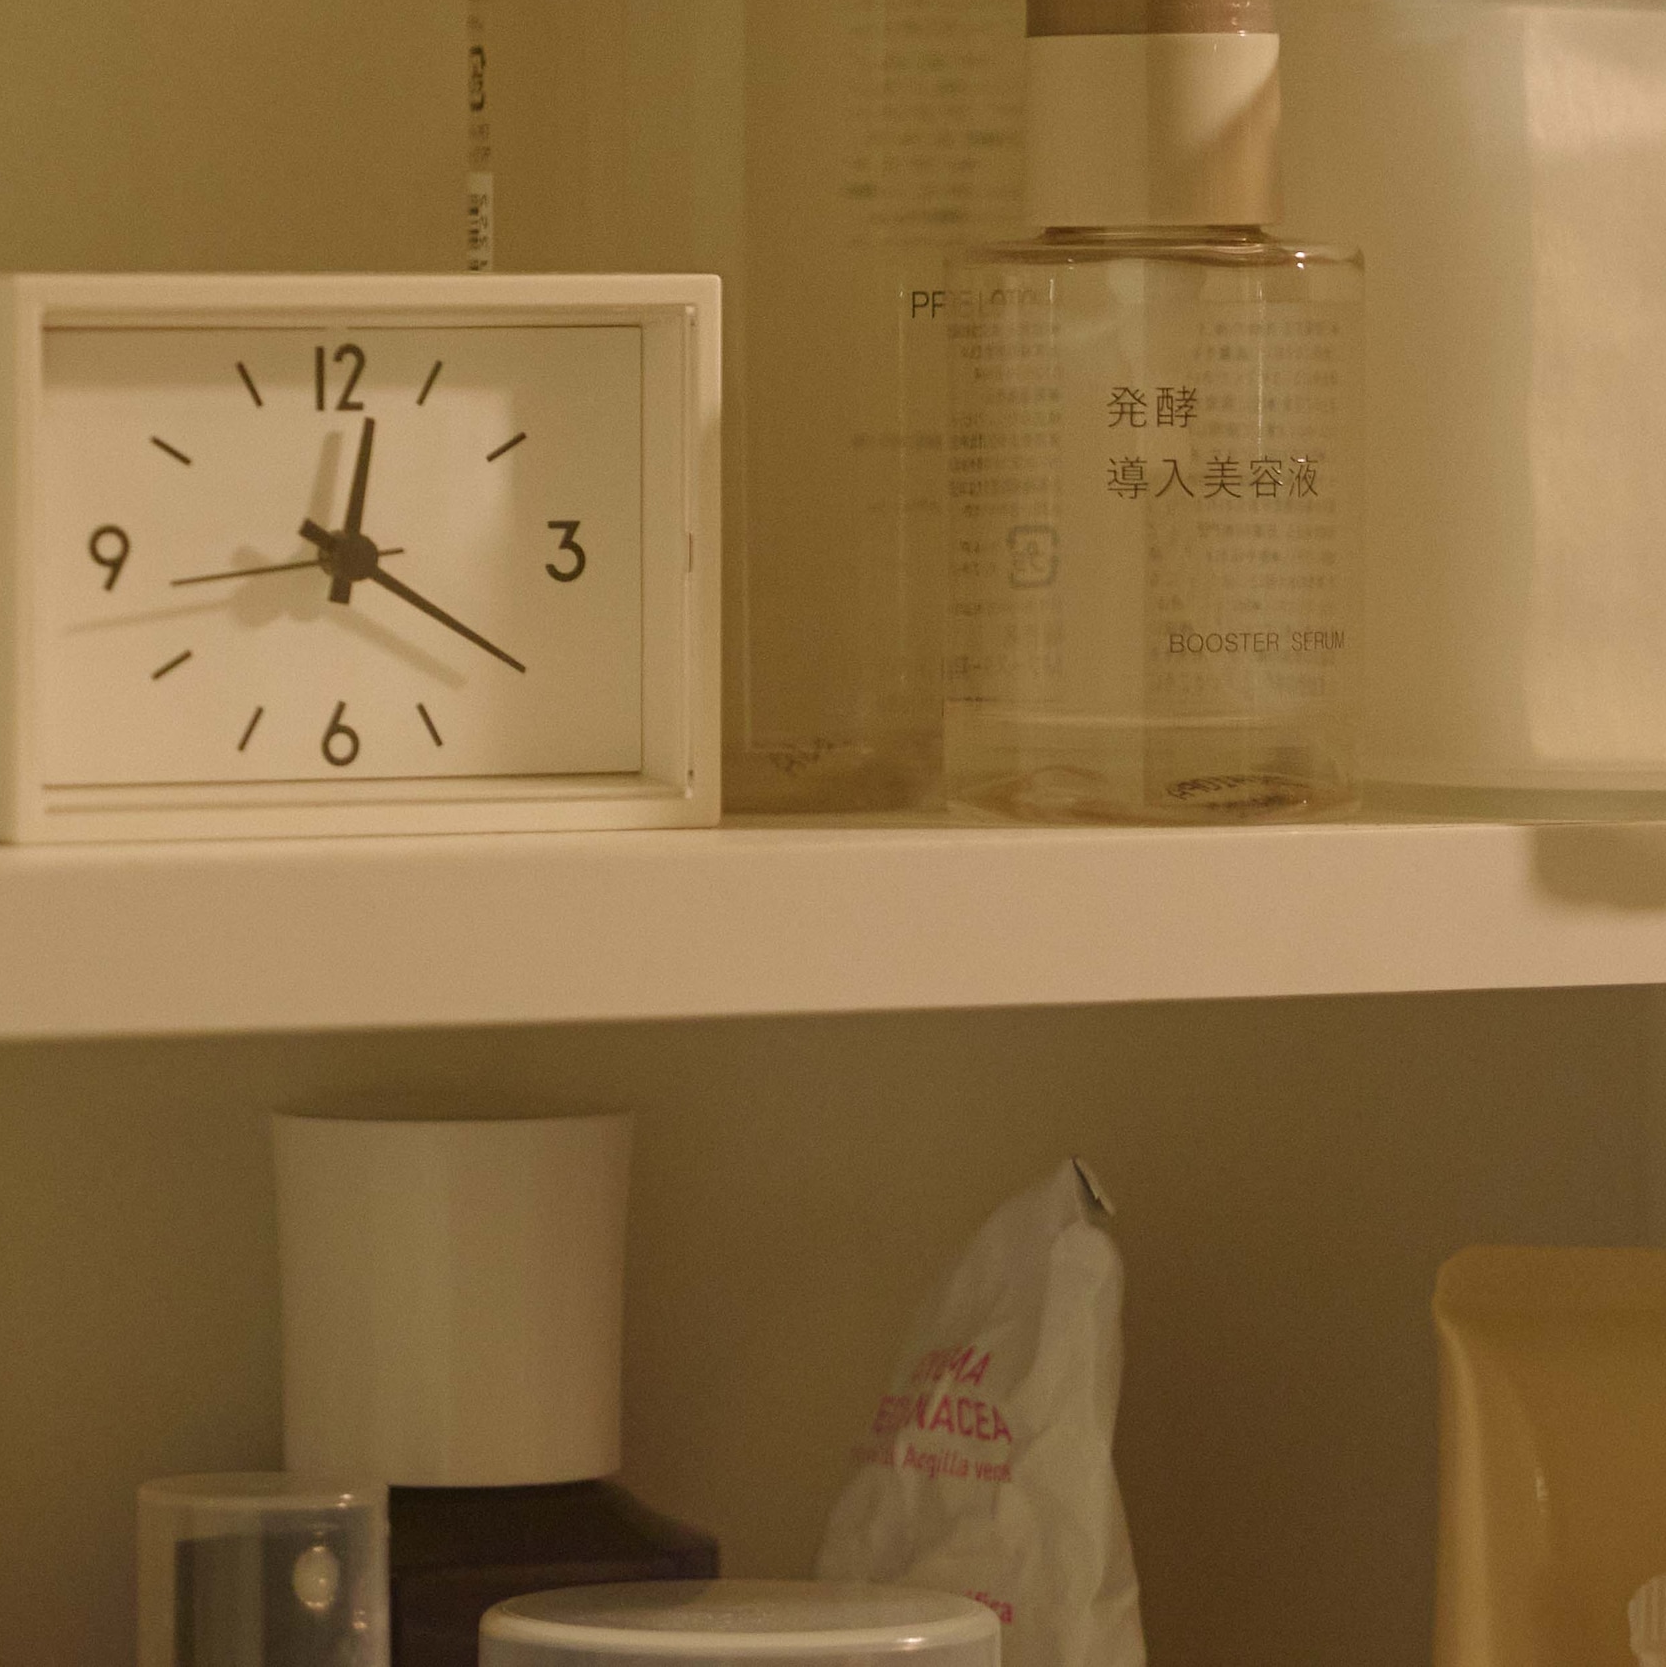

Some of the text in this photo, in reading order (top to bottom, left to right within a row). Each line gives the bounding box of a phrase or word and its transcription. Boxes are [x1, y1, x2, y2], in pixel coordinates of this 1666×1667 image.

[315, 343, 366, 411] 12
[1107, 385, 1199, 429] 発酵
[1107, 456, 1319, 499] 導入美容液
[89, 525, 131, 591] 9
[545, 520, 586, 582] 3
[1169, 631, 1345, 654] BOOSTER SERUM
[321, 701, 360, 766] 6
